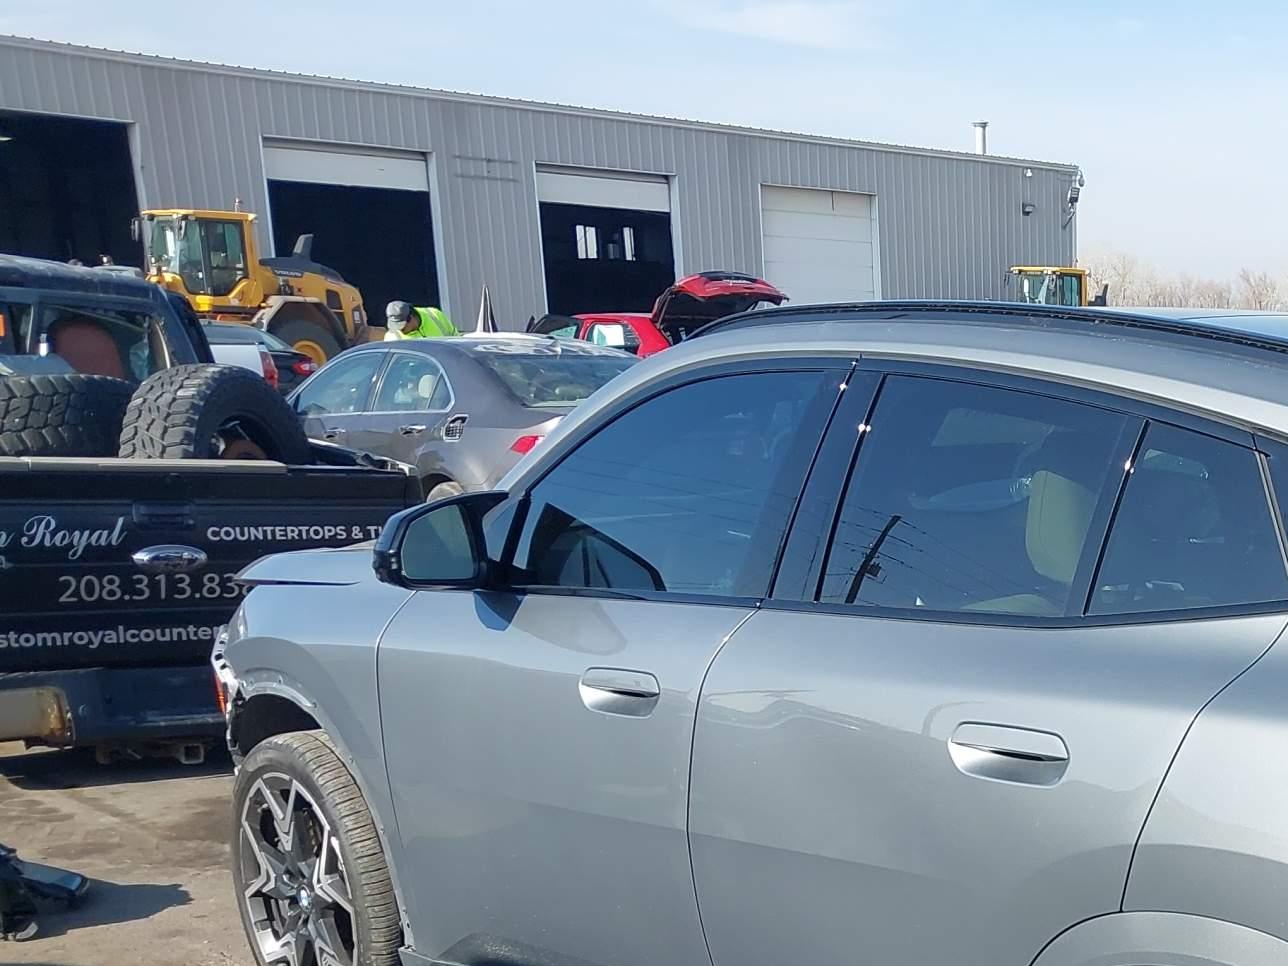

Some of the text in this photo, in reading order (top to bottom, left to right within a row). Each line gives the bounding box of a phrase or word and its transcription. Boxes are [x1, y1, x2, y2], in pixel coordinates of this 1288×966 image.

[21, 515, 128, 560] Royal
[207, 525, 347, 541] COUNTERTOPS
[351, 525, 364, 539] &
